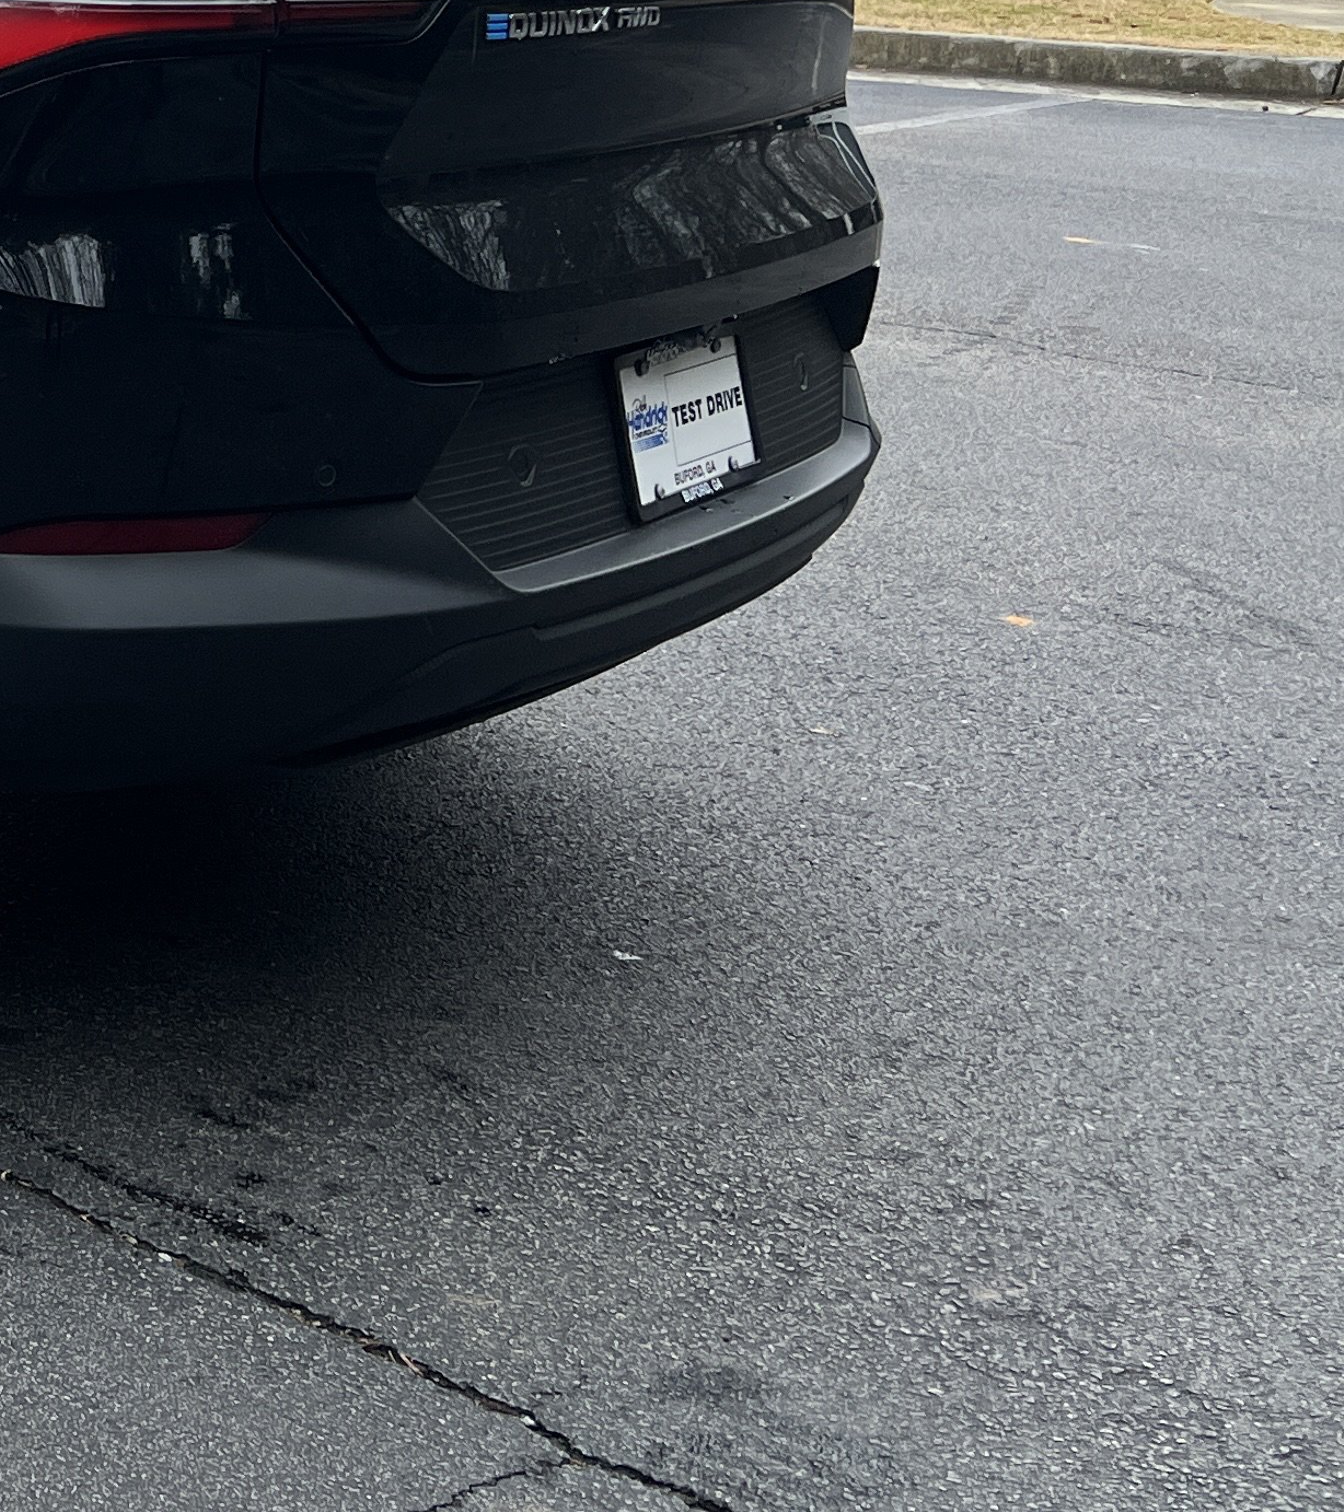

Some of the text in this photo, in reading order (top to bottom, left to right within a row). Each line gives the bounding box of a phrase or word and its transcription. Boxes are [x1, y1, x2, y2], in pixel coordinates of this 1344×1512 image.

[486, 6, 611, 40] EQUINOX
[672, 386, 743, 427] TEST DRIVE
[705, 460, 717, 474] GA
